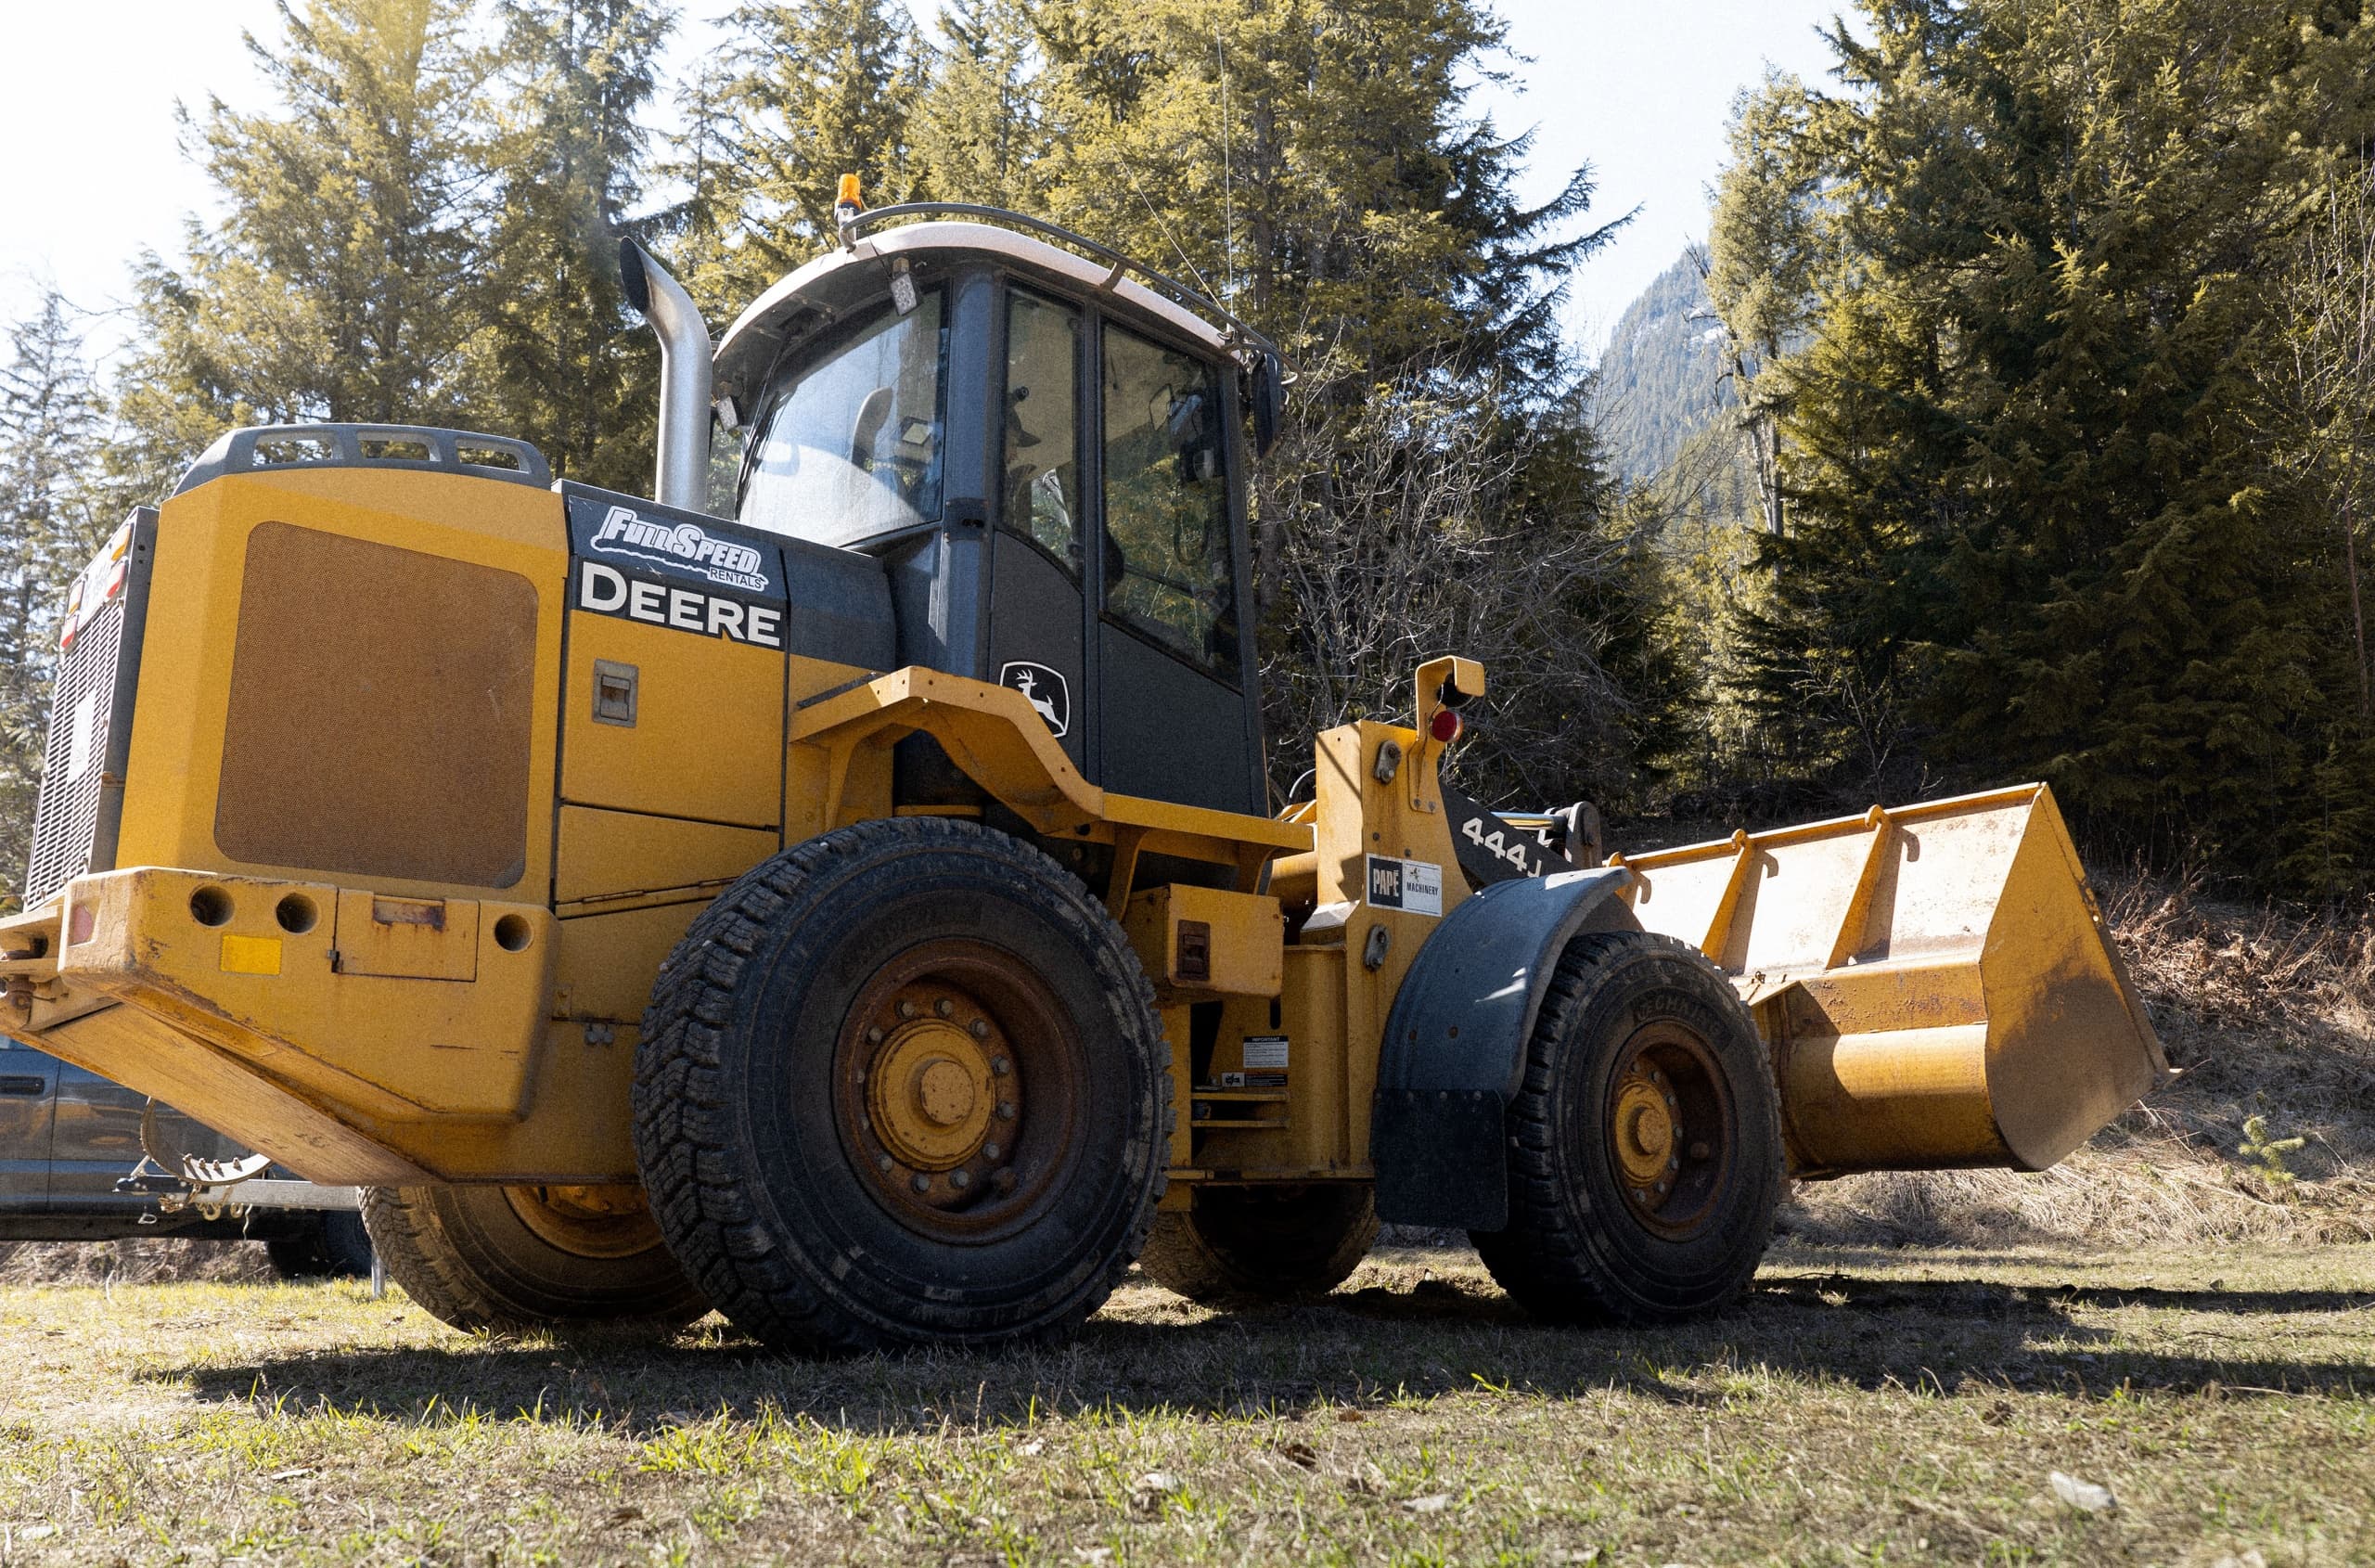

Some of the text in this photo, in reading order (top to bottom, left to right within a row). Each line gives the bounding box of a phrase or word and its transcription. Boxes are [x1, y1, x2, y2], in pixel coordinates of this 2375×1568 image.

[710, 568, 763, 589] RENTALS
[581, 561, 781, 647] DEERE
[1462, 817, 1542, 878] 444J
[1406, 882, 1439, 896] MACHINERY
